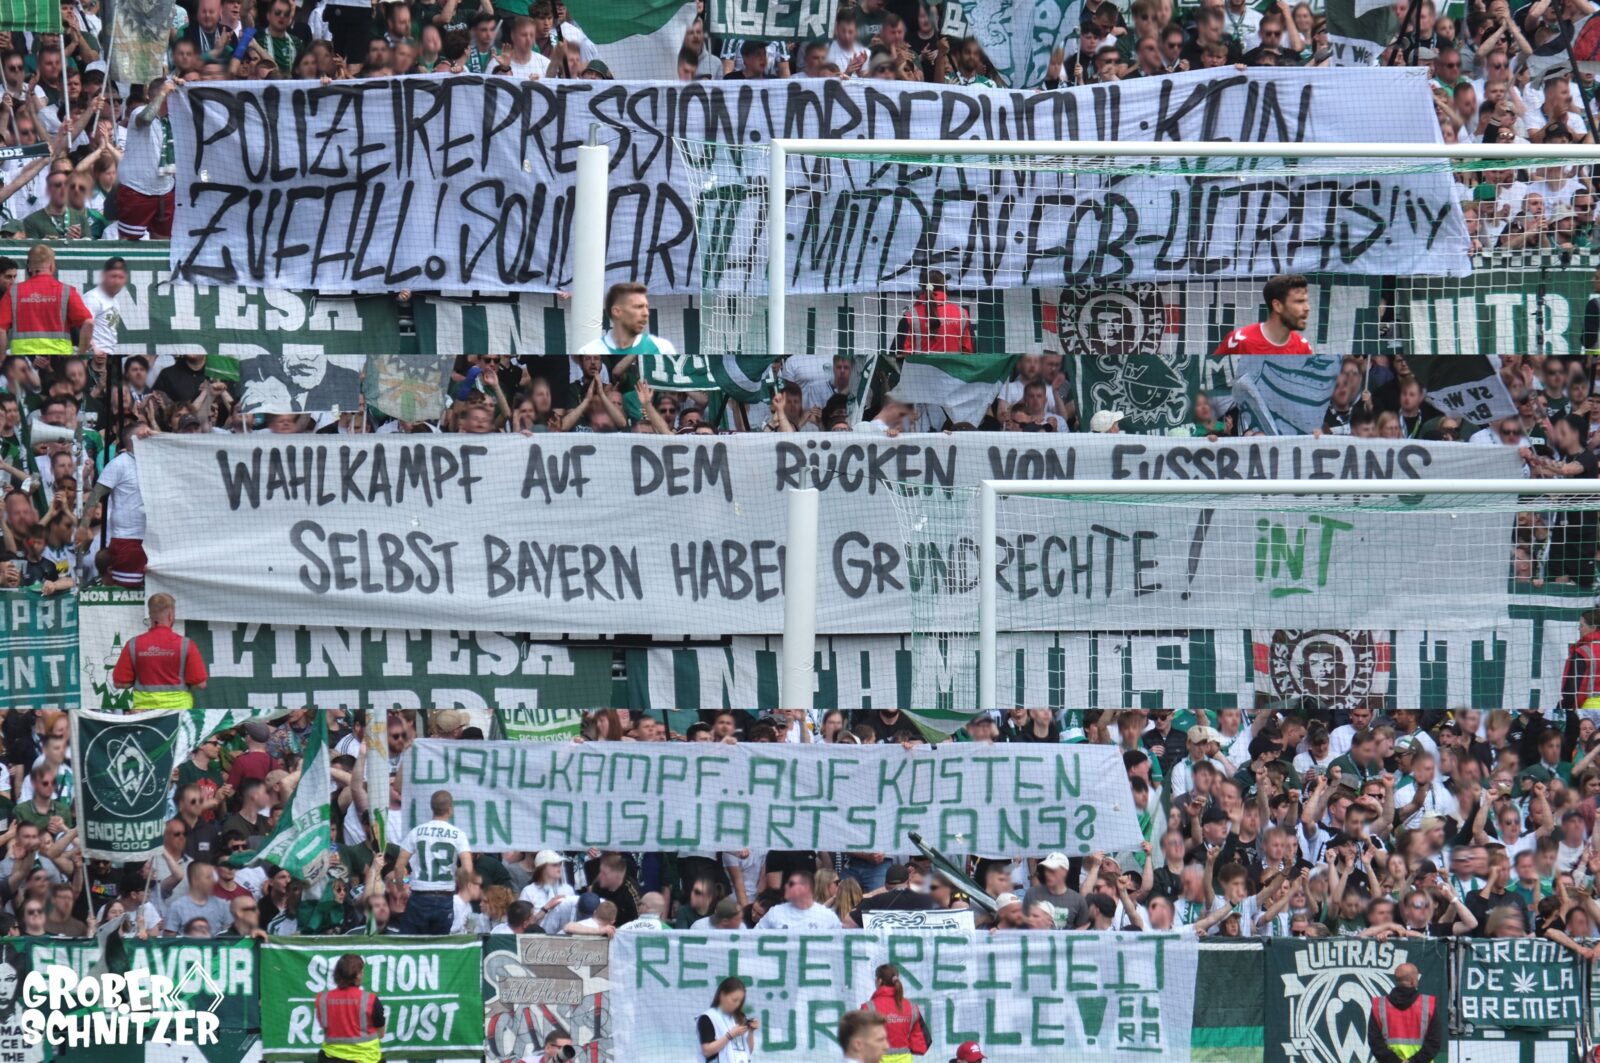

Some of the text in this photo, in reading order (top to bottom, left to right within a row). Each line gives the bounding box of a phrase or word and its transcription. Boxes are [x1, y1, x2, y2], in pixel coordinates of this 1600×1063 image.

[178, 180, 446, 285] ZUFALL!
[216, 443, 487, 510] WAHLKAMPF
[521, 443, 596, 504] AUF
[631, 442, 733, 502] DEM
[775, 440, 957, 500] RÜCKEN
[988, 446, 1076, 500] VON
[290, 520, 458, 594] SELBST
[483, 534, 643, 602] BAYERN
[670, 539, 786, 602] HABE
[411, 746, 1081, 806] WAHLKAMPF AUF KOSTEN
[416, 826, 459, 839] ULTRAS
[417, 840, 456, 882] 12
[636, 934, 1181, 991] REISEFREIHEIT
[1308, 941, 1395, 968] ULTRAS
[1467, 967, 1574, 991] DE LA
[742, 990, 851, 1052] ÜR
[1462, 996, 1580, 1019] BREMEN
